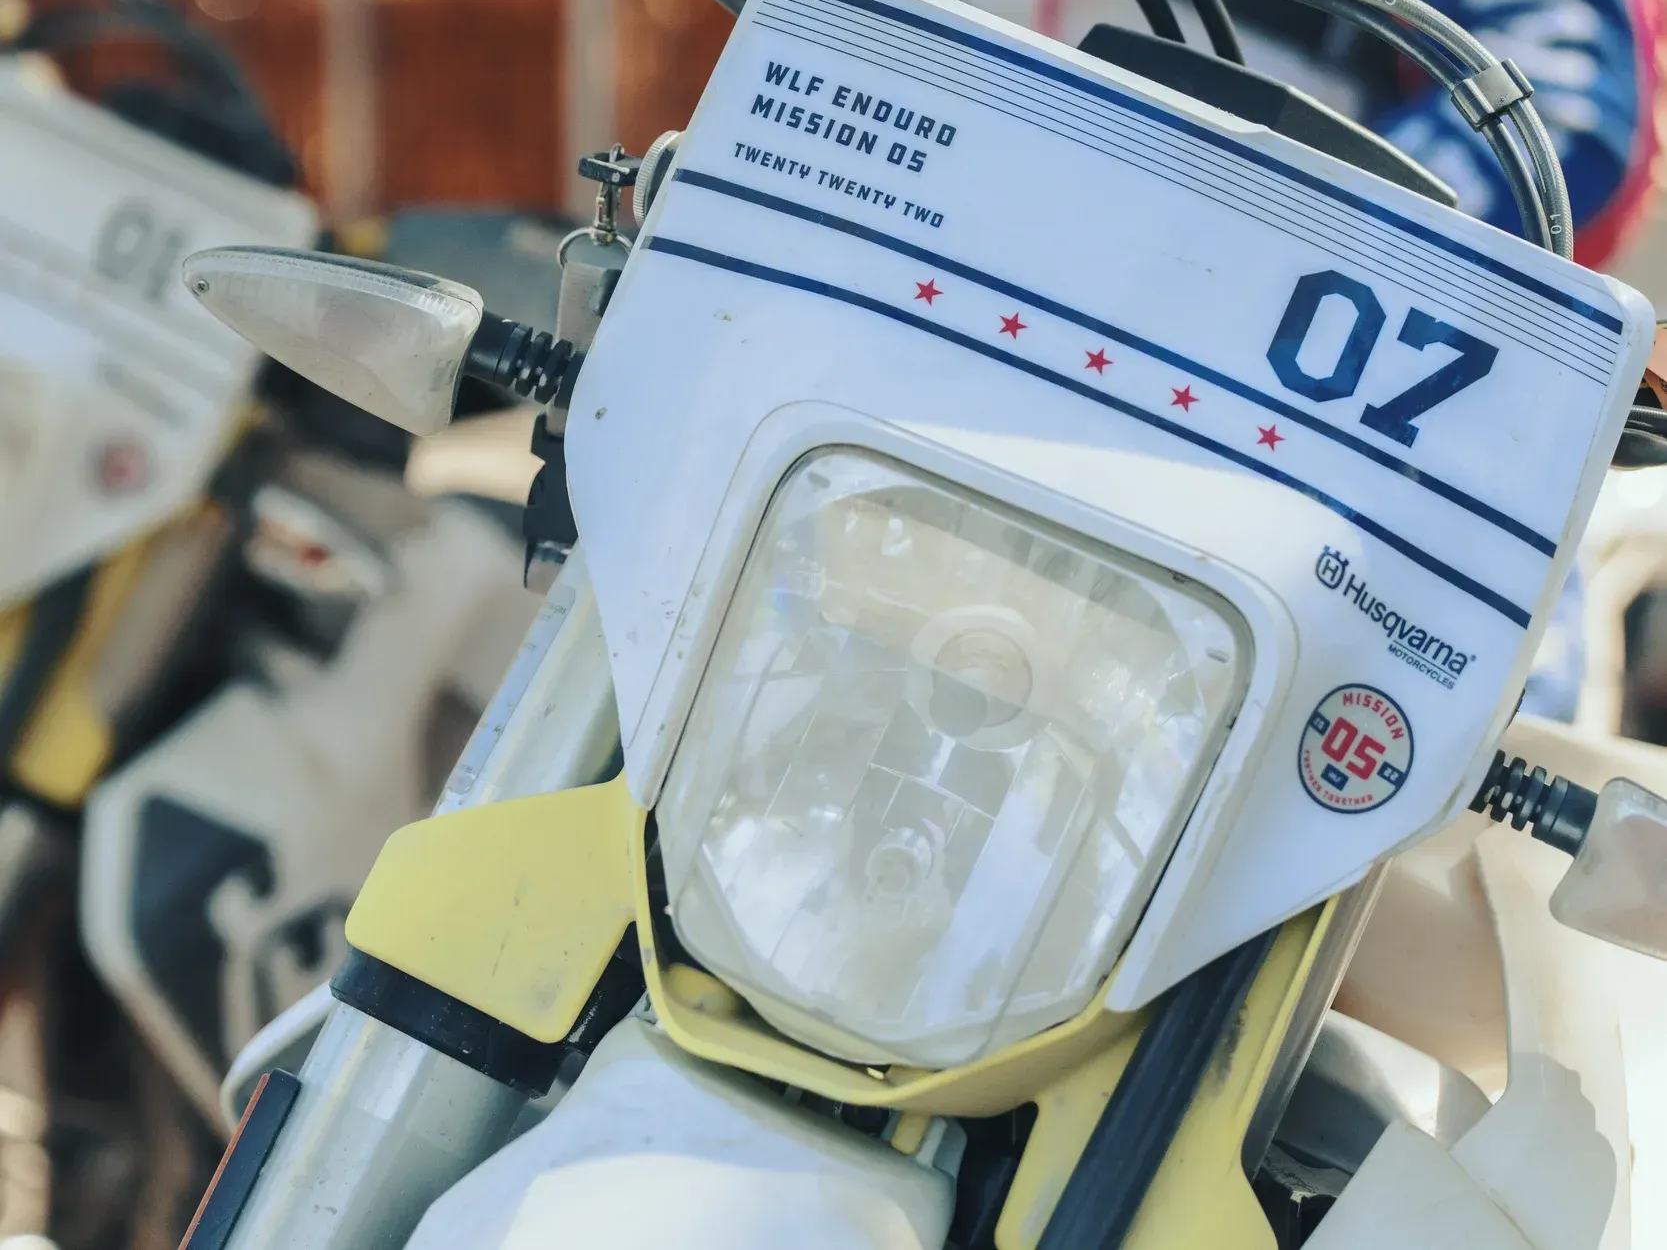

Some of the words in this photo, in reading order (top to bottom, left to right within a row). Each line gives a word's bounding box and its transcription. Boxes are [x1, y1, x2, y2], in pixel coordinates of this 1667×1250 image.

[750, 94, 879, 155] MISSION
[886, 141, 928, 173] 05
[764, 61, 824, 96] WLF
[831, 85, 957, 147] ENDURO
[734, 142, 811, 179] TWENTY
[817, 169, 897, 209] TWENTY
[902, 201, 945, 228] TWO
[1265, 269, 1500, 449] 07
[1342, 573, 1469, 676] Husqvarna
[1387, 642, 1455, 690] MOTORCYCLES
[1321, 716, 1387, 781] 05
[1342, 692, 1405, 741] MISSION
